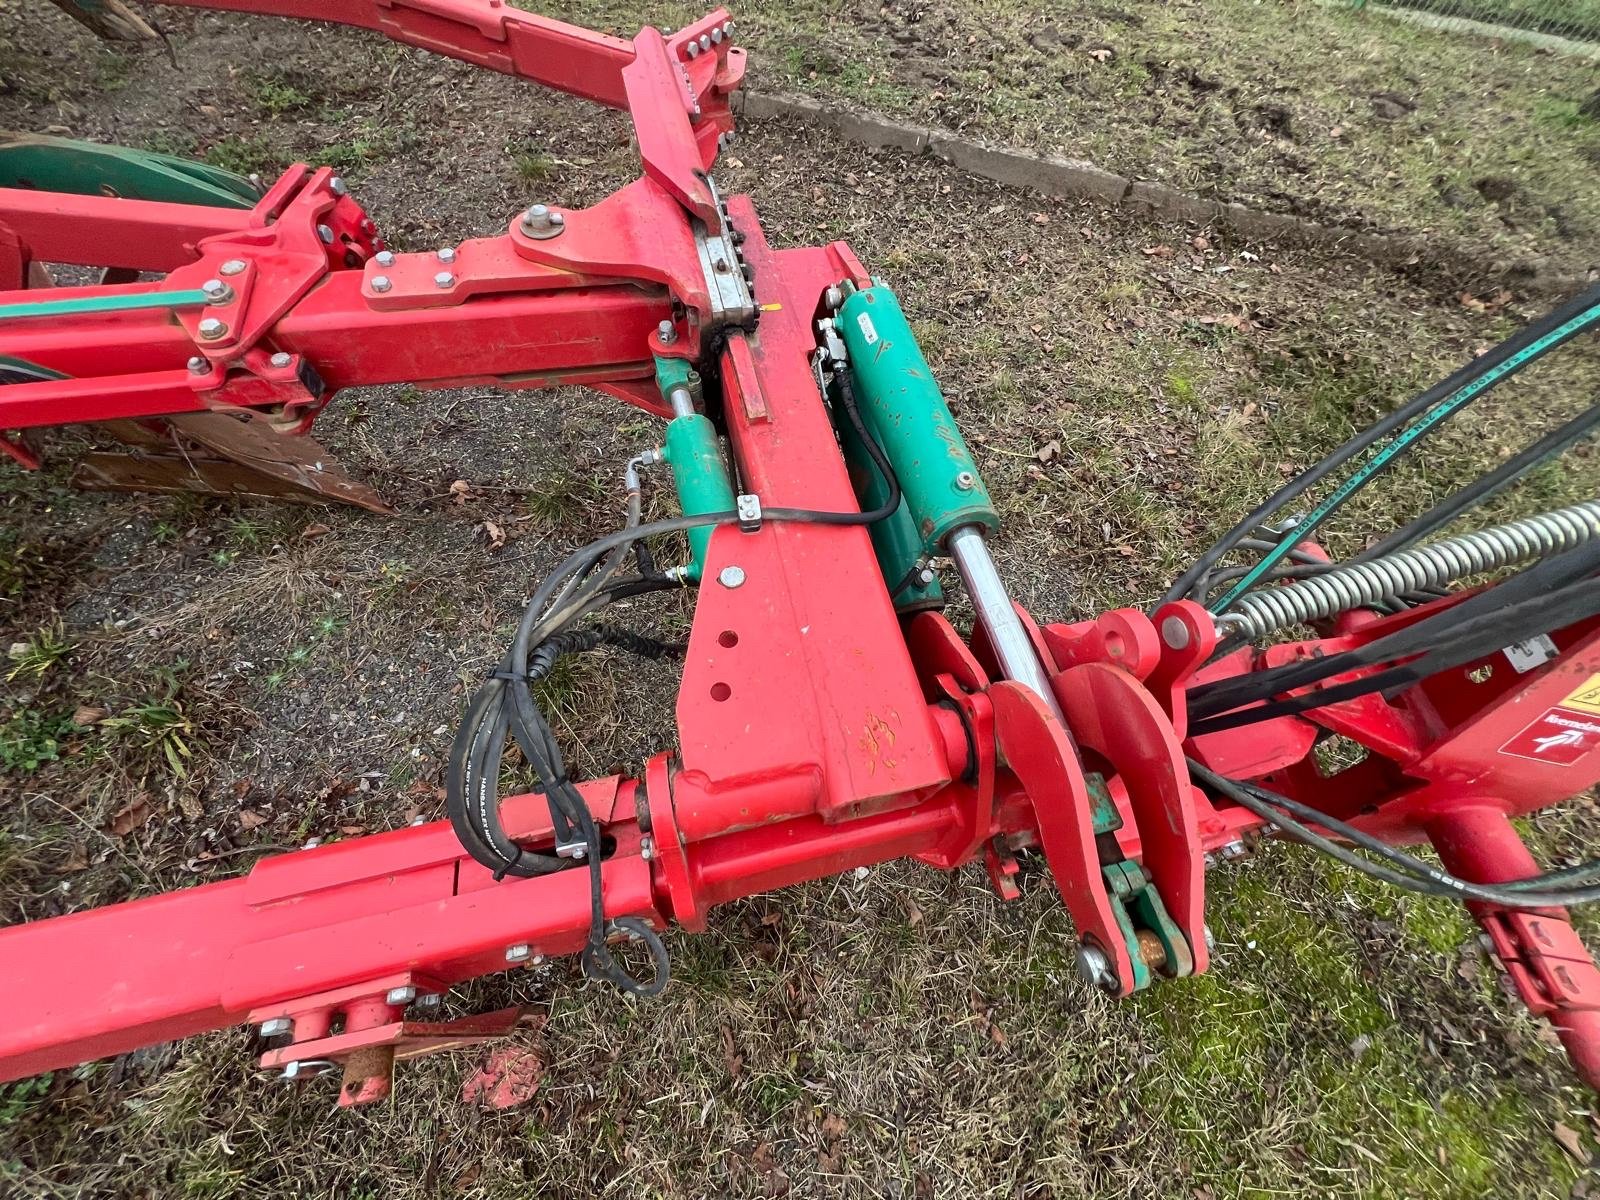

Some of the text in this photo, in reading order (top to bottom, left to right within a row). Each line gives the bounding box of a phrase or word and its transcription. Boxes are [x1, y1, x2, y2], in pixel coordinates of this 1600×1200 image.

[1470, 374, 1492, 389] 100
[1445, 391, 1468, 407] R2S
[1414, 415, 1434, 431] 2SN
[480, 776, 488, 828] HANSA-FLEX
